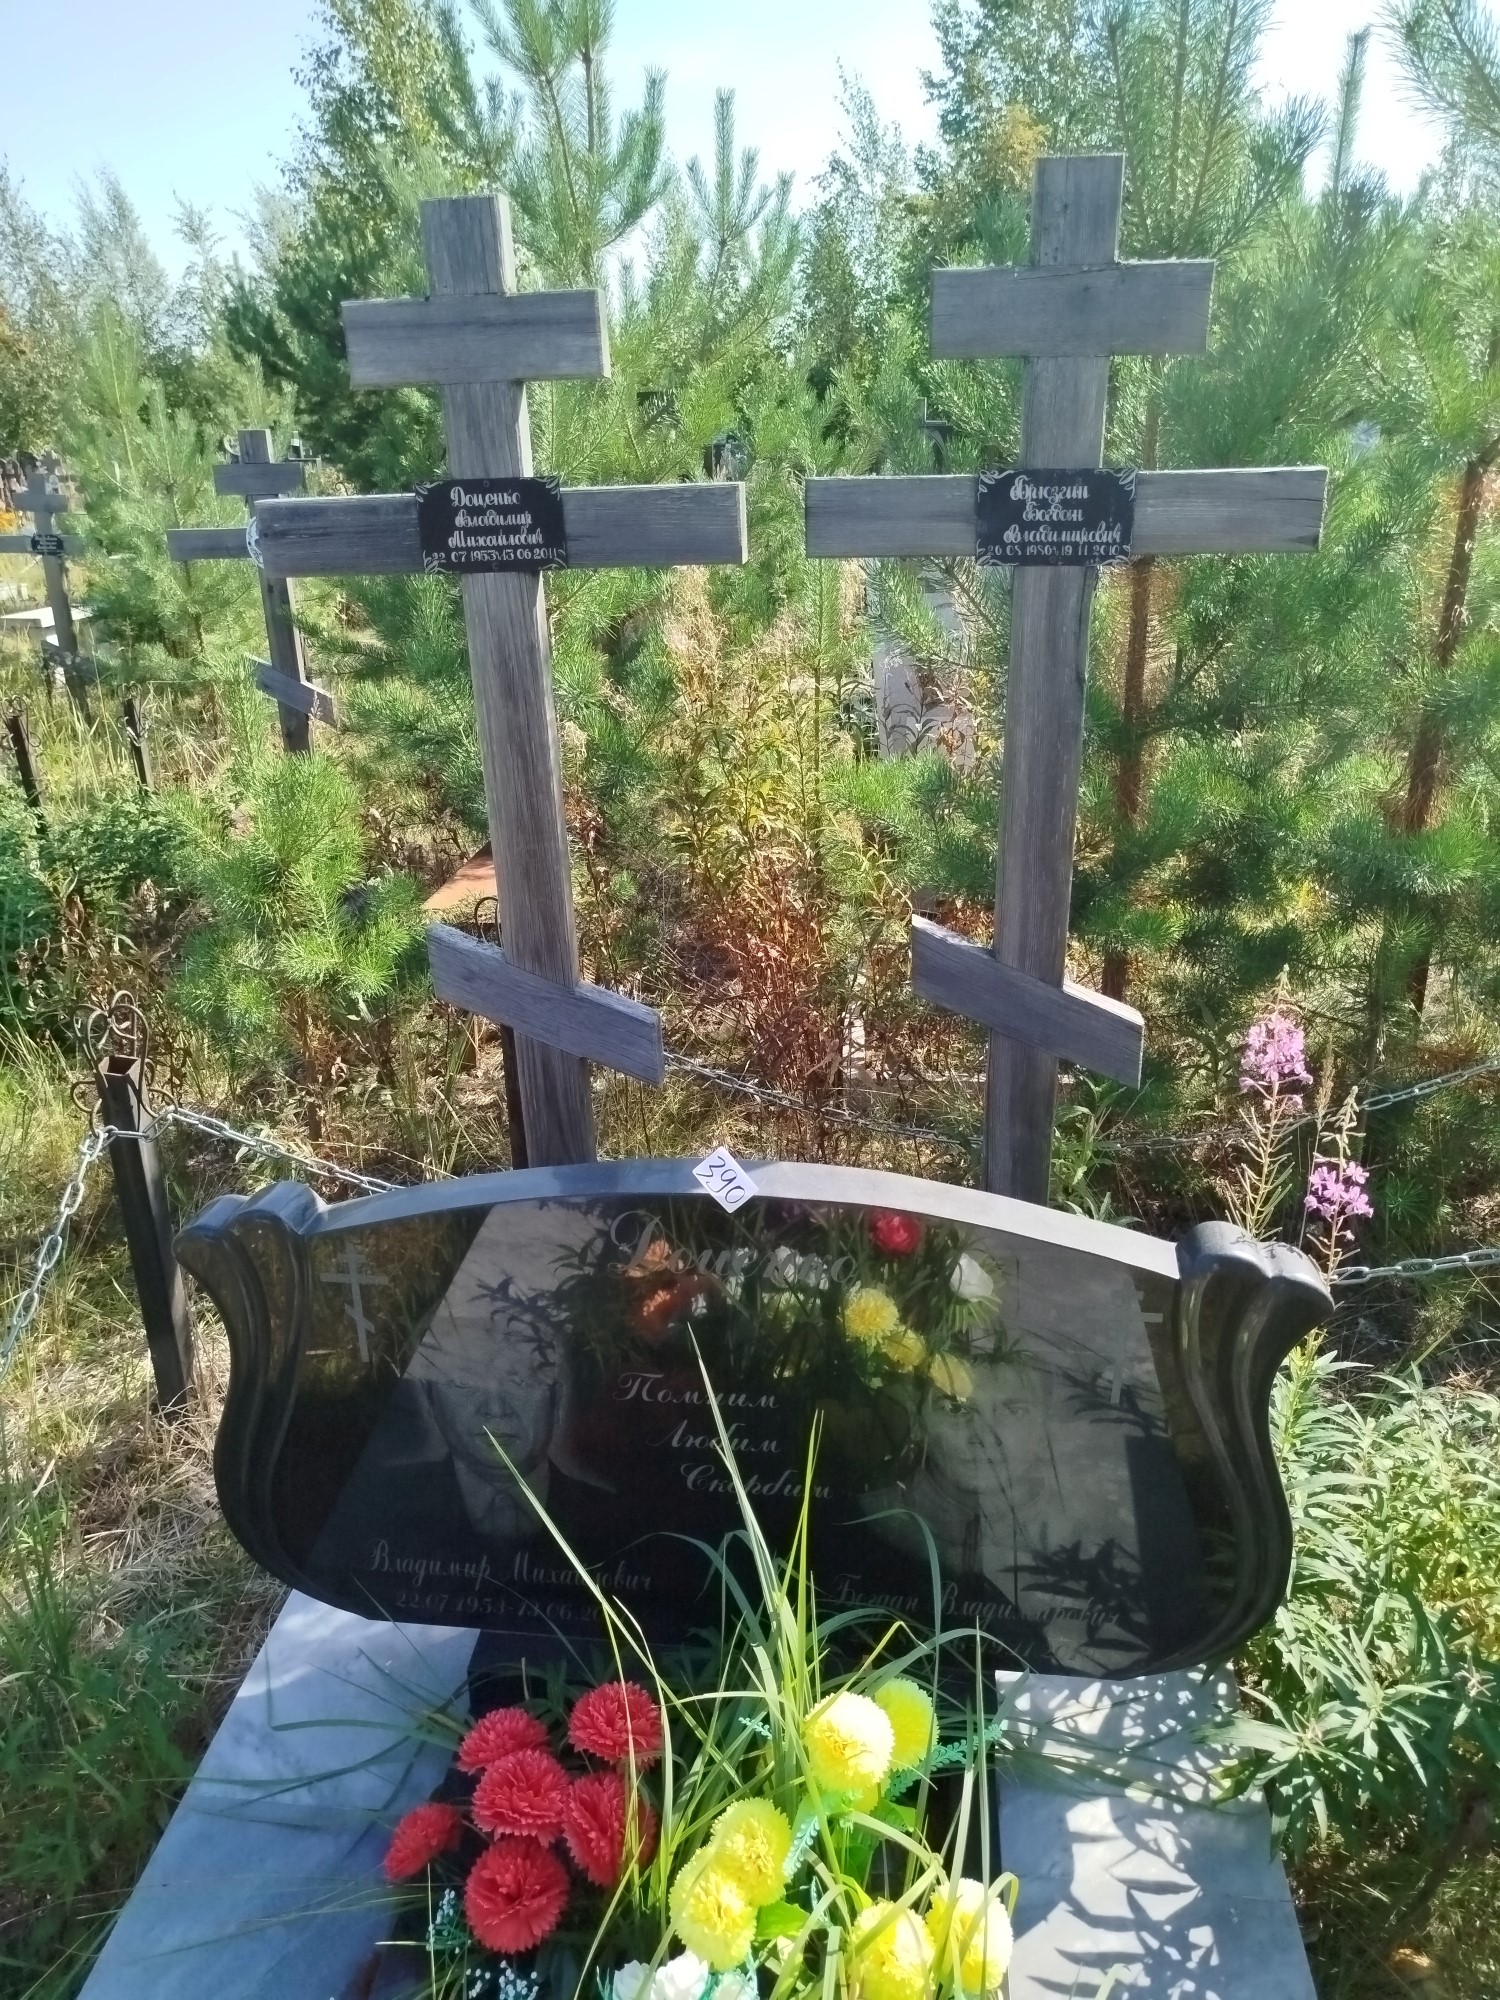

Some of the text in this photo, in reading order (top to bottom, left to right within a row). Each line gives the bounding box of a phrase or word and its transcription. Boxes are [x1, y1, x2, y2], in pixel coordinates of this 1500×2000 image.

[450, 486, 521, 508] Доценко
[454, 509, 533, 528] Владимир
[1023, 501, 1085, 522] Богдан
[448, 526, 544, 549] Михайлович
[1003, 521, 1122, 545] Владимирович
[431, 552, 447, 564] 22
[451, 551, 467, 563] 07
[517, 548, 531, 560] 06
[533, 547, 557, 560] 2011
[1061, 544, 1073, 556] 19
[1077, 544, 1088, 556] 11
[1092, 544, 1120, 556] 2010
[696, 1155, 746, 1204] 390
[607, 1210, 857, 1288] Доценко
[648, 1419, 781, 1454] Любим
[367, 1538, 491, 1591] Владимир
